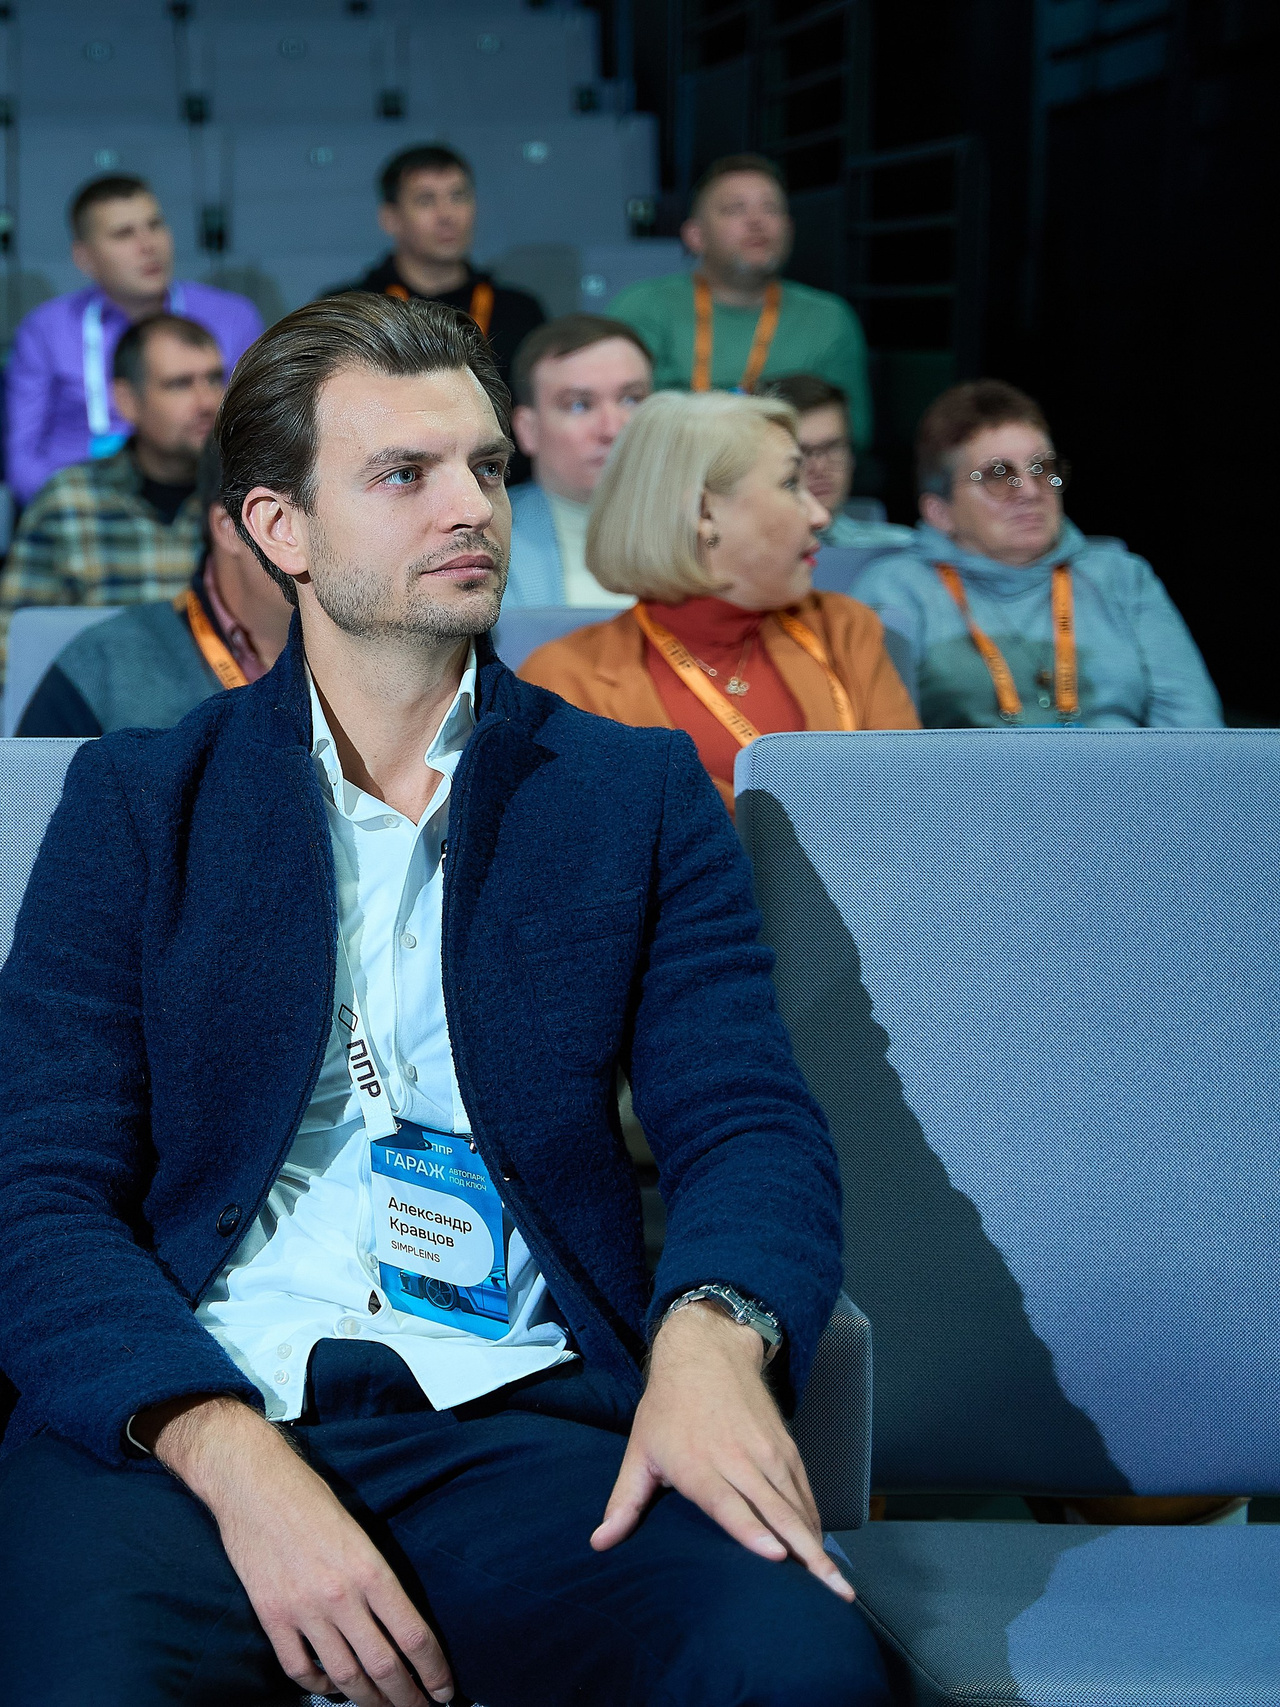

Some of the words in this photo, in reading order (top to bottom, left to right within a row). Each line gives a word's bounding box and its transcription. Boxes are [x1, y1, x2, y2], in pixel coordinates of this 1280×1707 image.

[346, 1038, 382, 1098] ППР
[431, 1142, 453, 1155] ППР
[385, 1149, 446, 1181] ГАРАЖ
[448, 1167, 486, 1183] АВТОПАРК
[449, 1176, 465, 1187] ПОД
[465, 1181, 487, 1192] КЛЮЧ
[388, 1196, 472, 1234] Александр
[389, 1216, 455, 1248] Кравцов
[391, 1240, 441, 1263] SIMPLEINS
